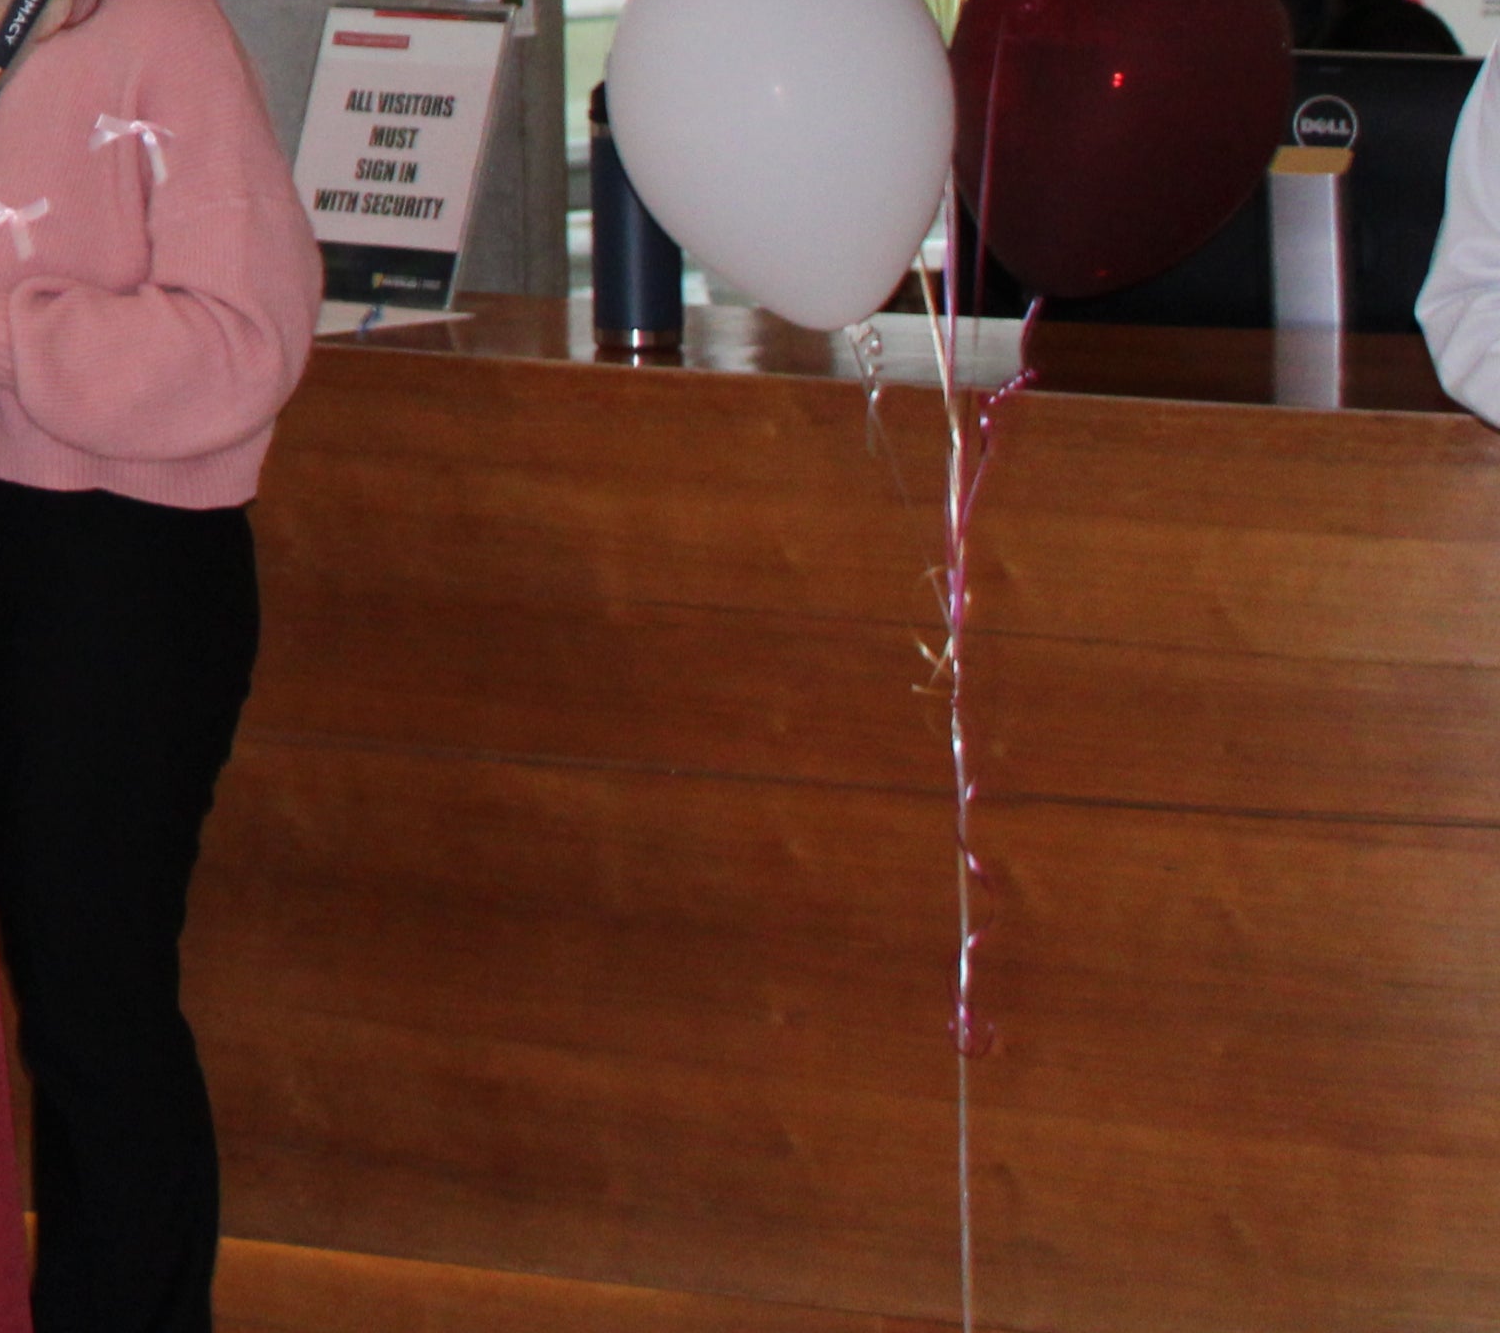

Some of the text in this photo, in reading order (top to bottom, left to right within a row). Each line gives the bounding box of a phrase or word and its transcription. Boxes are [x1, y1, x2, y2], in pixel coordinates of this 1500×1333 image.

[345, 89, 455, 118] ALL VISITORS
[369, 125, 419, 149] MUST
[355, 157, 418, 183] SIGN IN
[314, 189, 444, 220] WITH SECURITY
